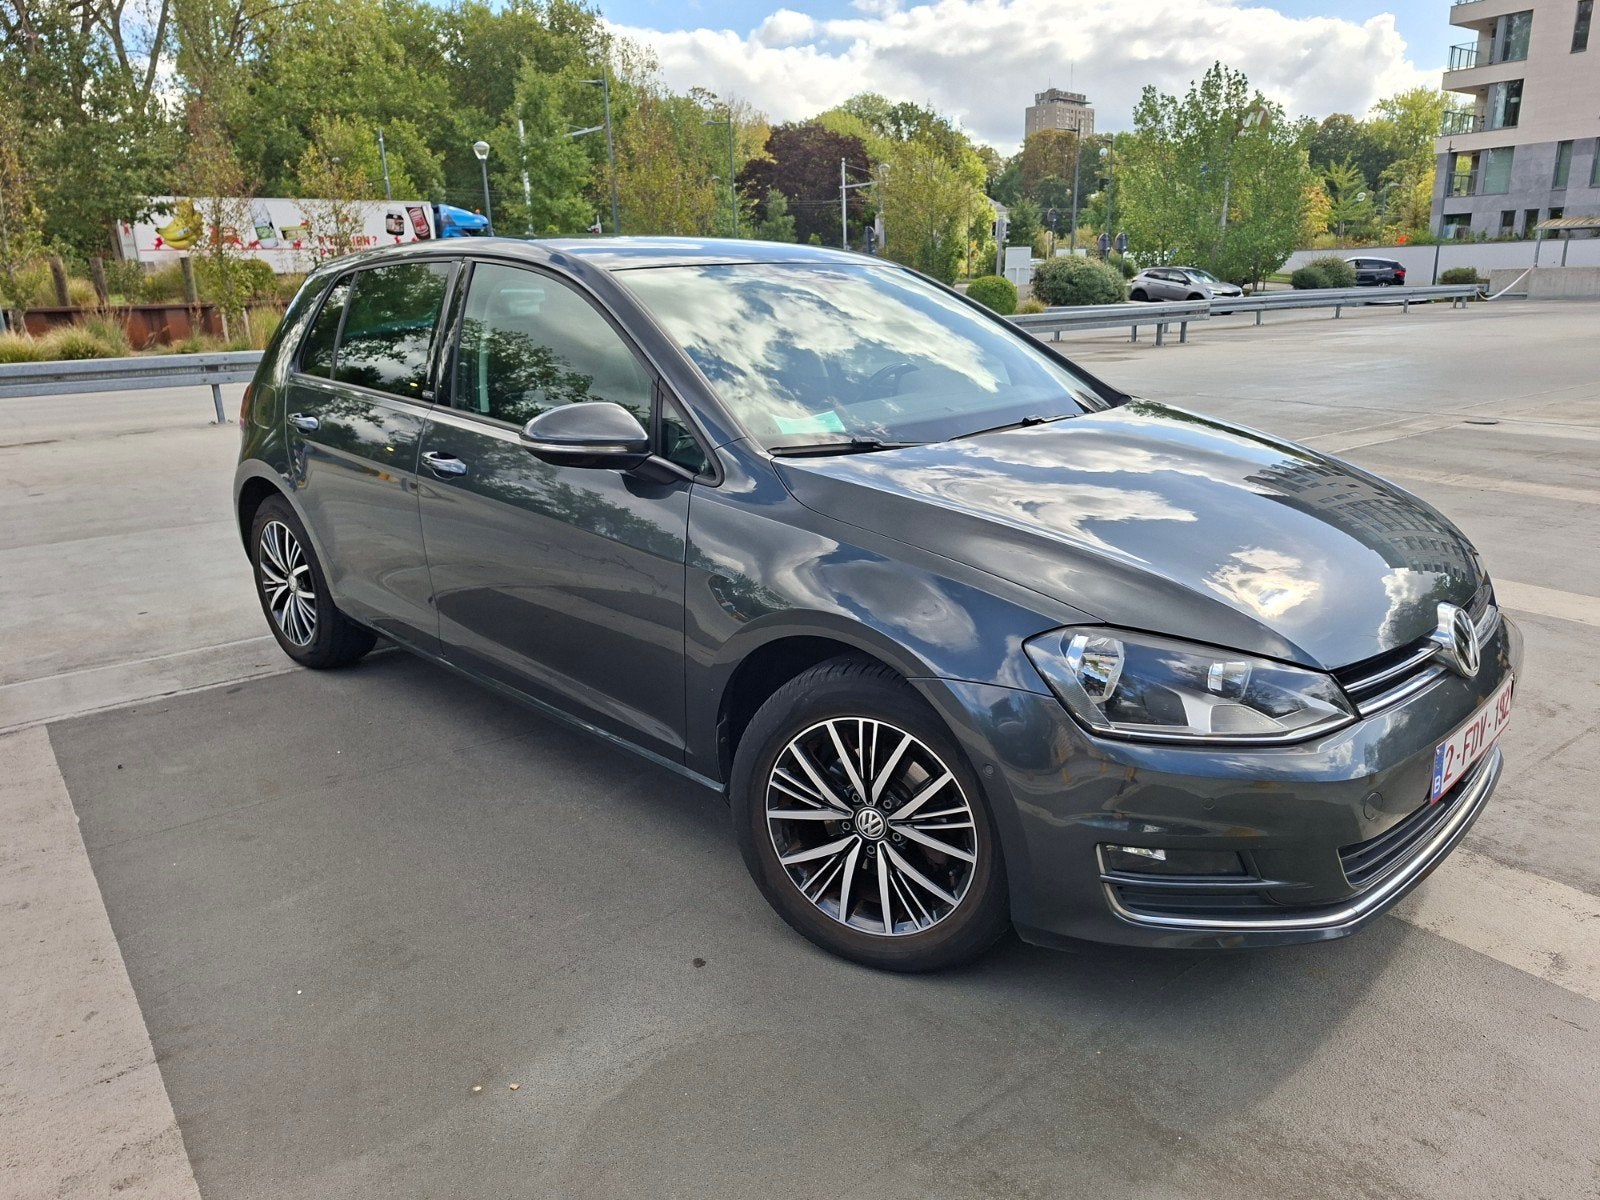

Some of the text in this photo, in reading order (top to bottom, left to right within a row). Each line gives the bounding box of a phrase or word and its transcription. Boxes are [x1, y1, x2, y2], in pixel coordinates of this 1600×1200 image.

[1444, 685, 1511, 783] 2-FDV-192
[1433, 776, 1442, 794] B
[858, 809, 884, 837] VW
